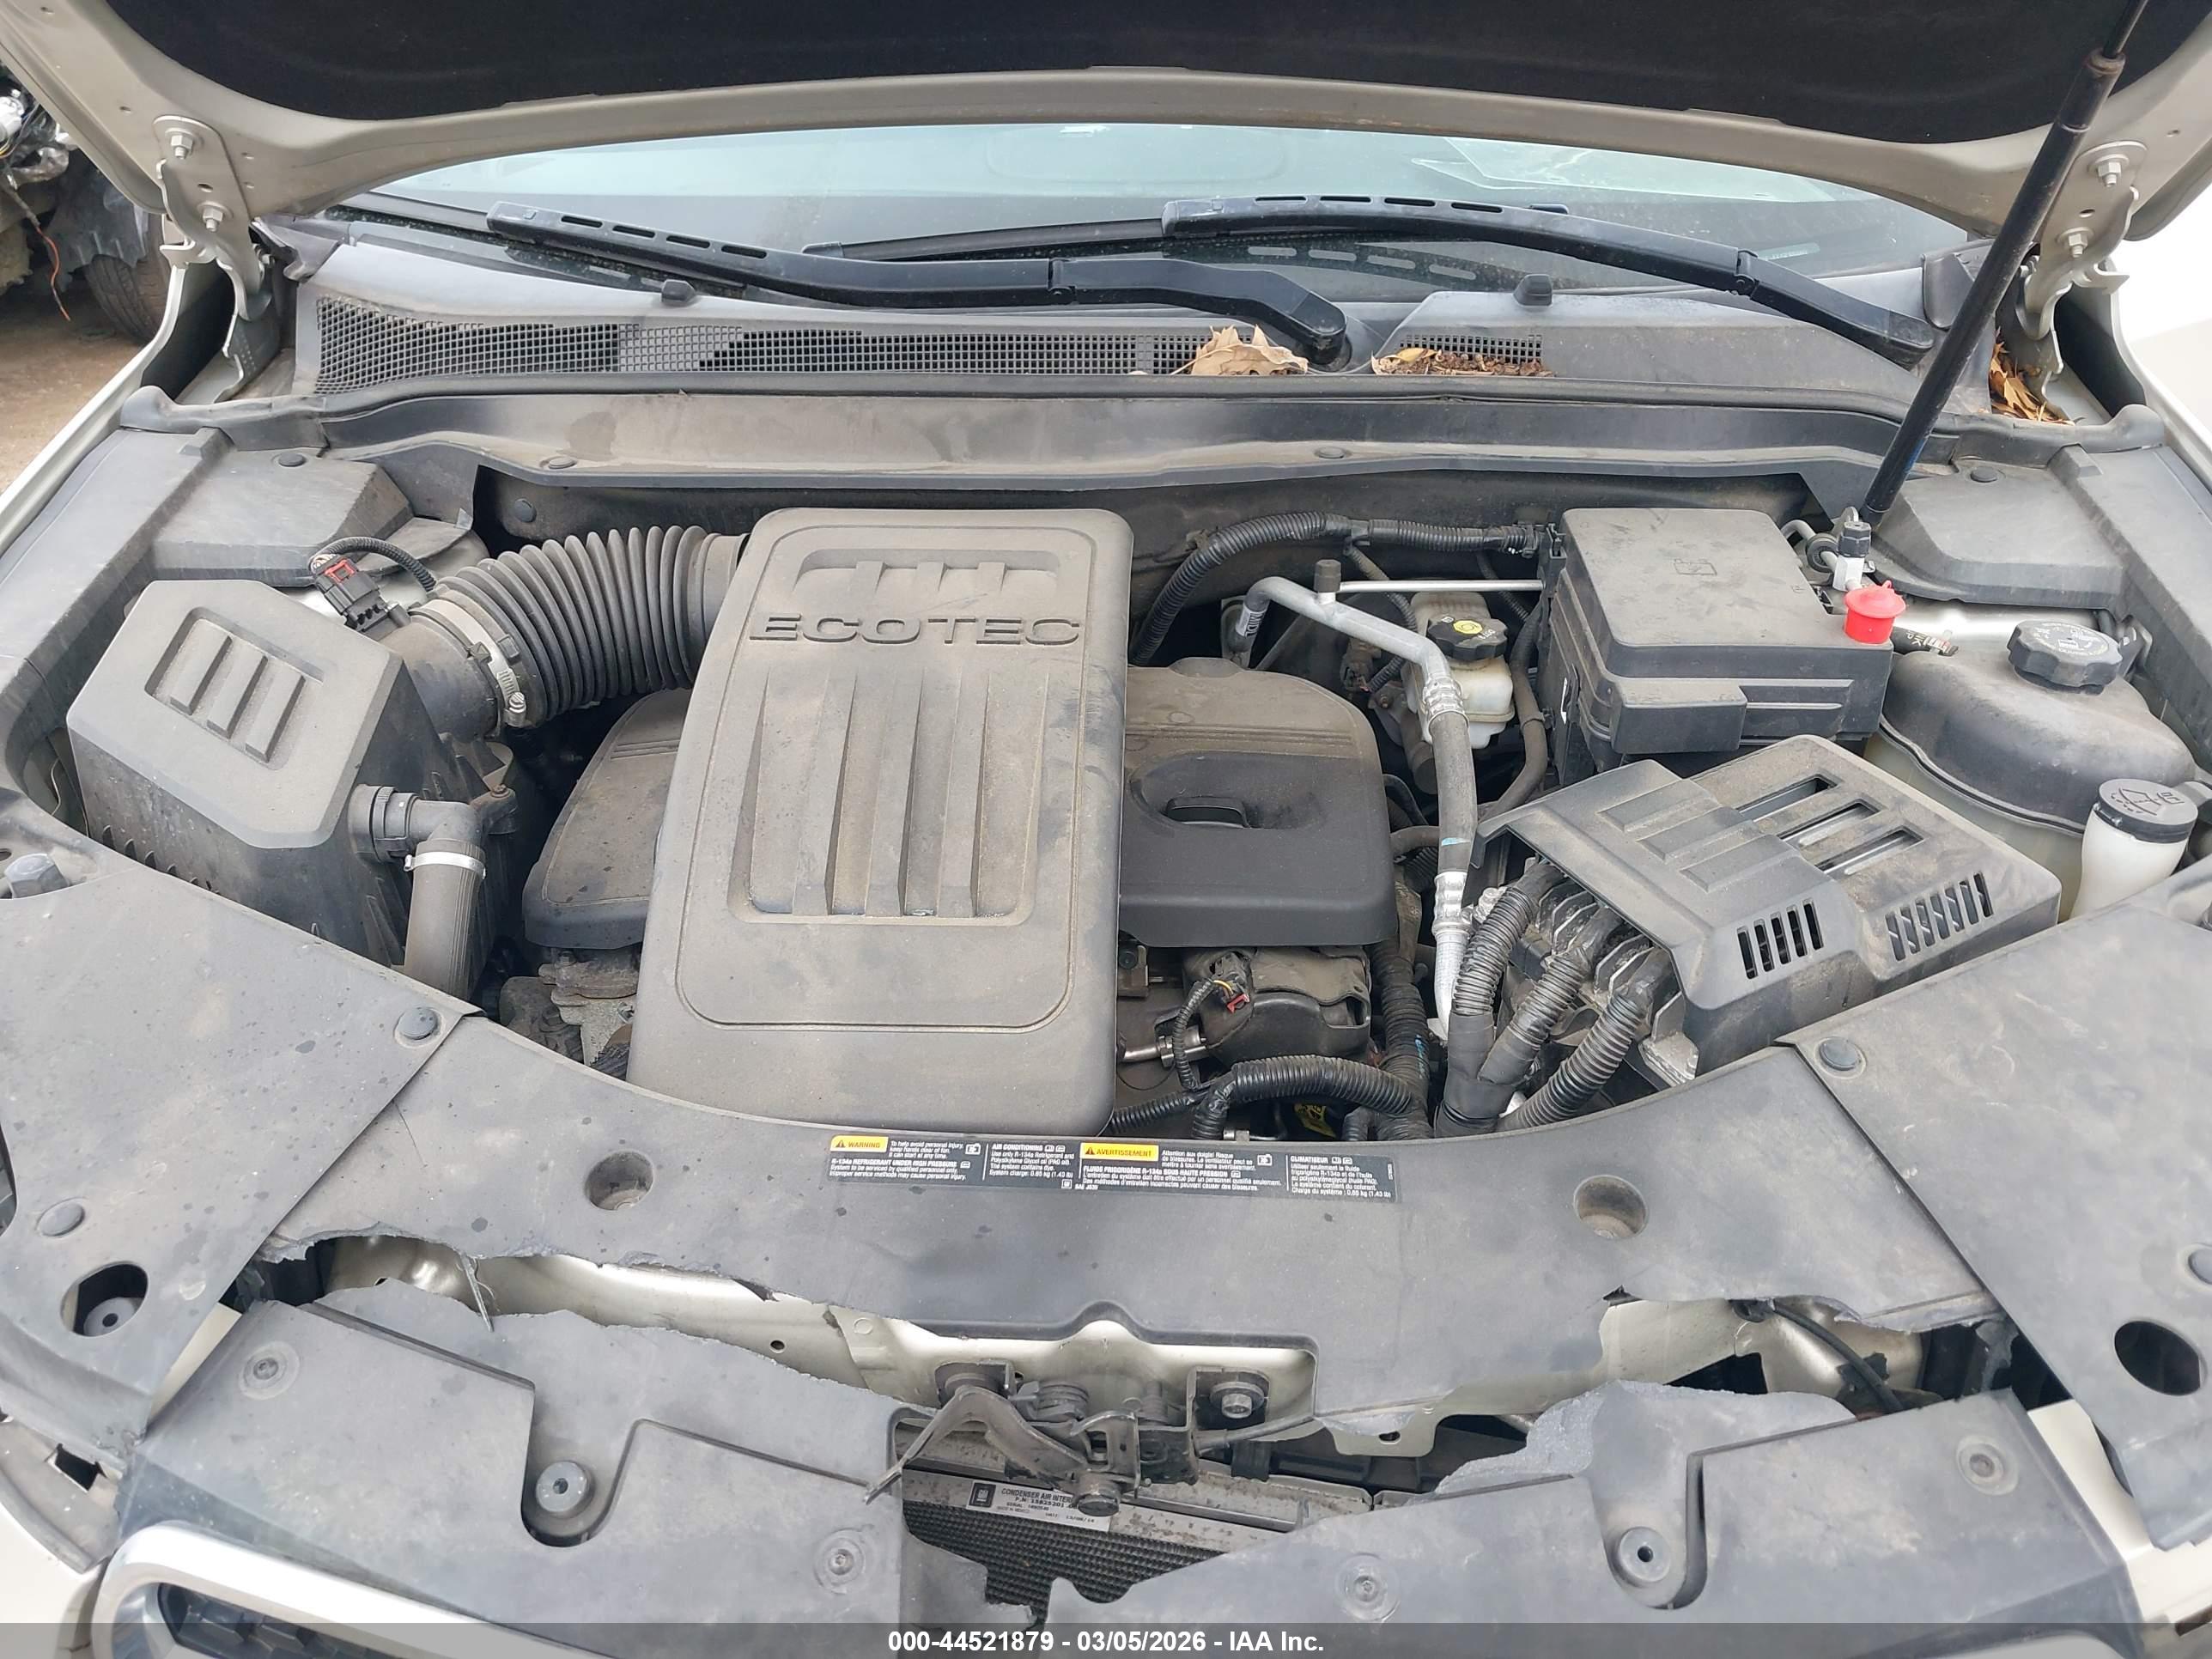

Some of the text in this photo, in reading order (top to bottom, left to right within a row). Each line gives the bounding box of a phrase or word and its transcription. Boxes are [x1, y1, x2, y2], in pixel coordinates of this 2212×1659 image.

[749, 612, 1081, 646] ECOTEC
[1097, 1148, 1152, 1157] AVERTISSEMENT
[1002, 1488, 1040, 1498] CONDENSER
